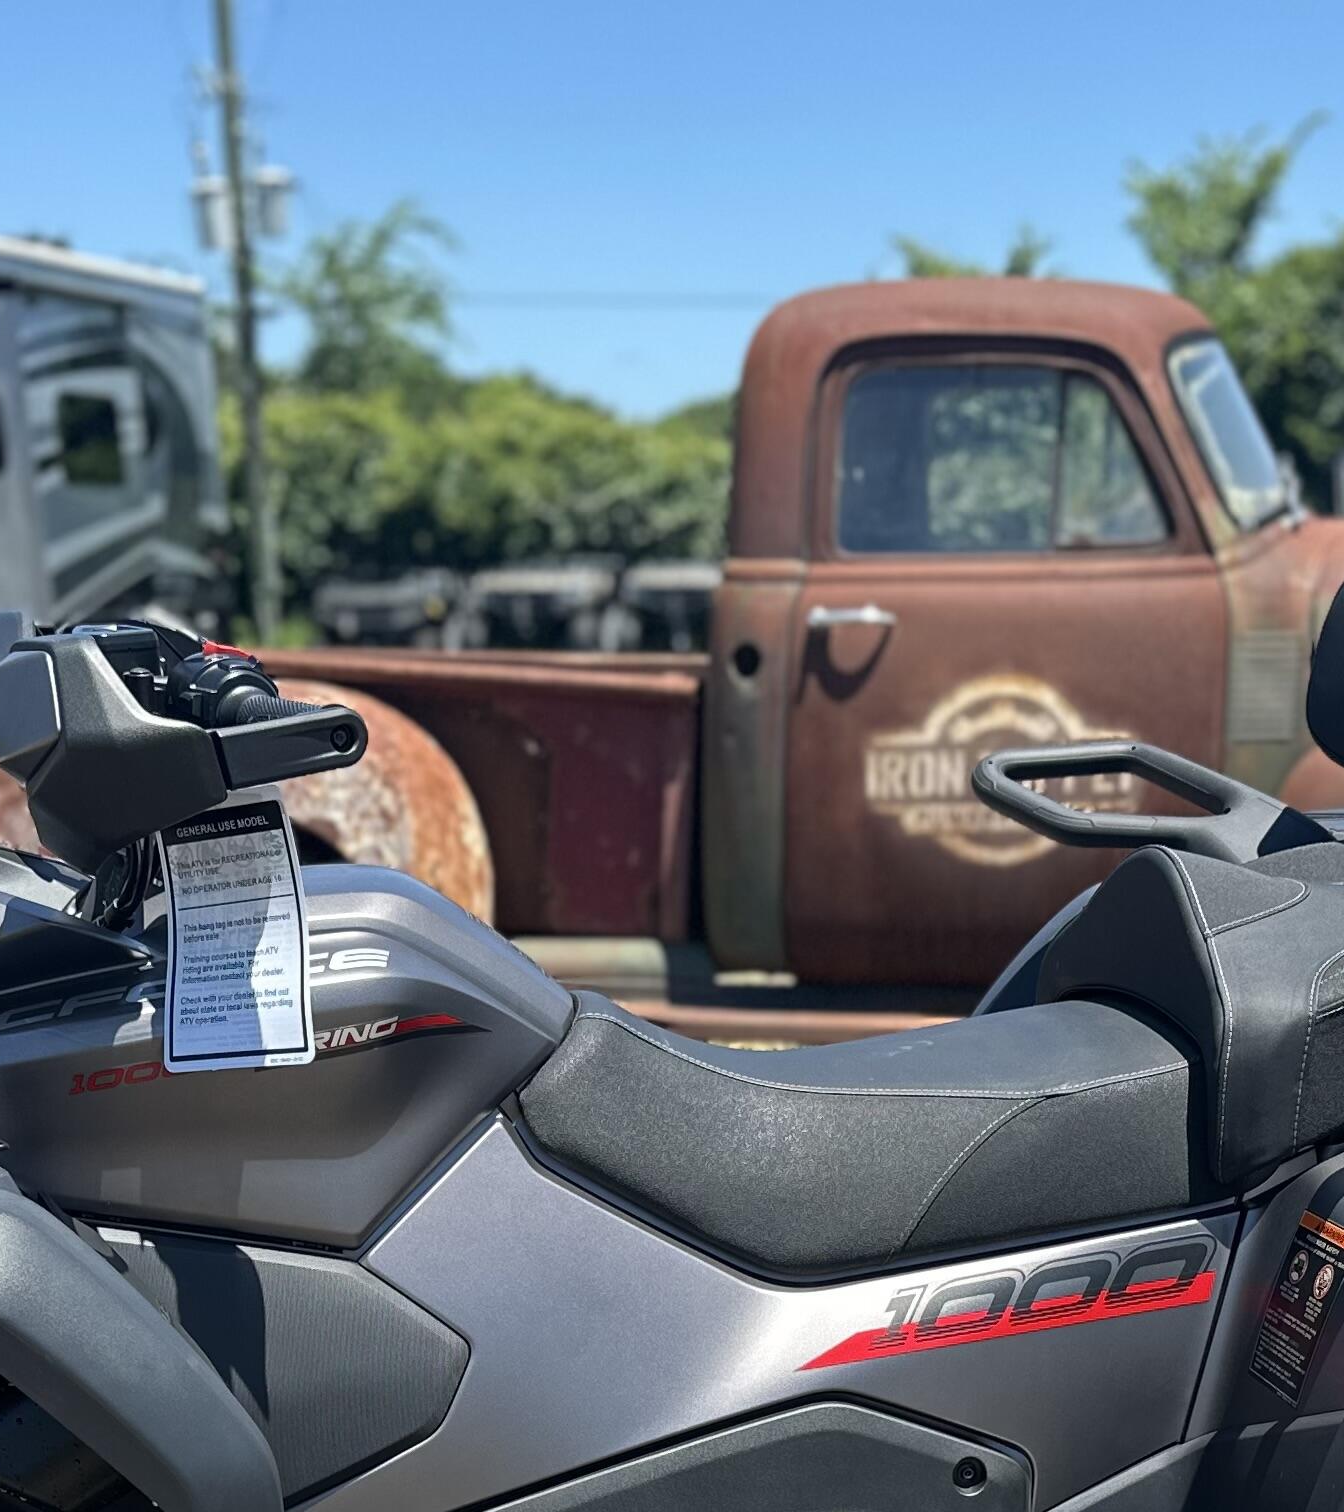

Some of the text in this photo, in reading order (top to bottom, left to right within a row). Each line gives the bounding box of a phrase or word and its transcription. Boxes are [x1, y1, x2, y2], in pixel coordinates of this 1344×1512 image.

[865, 749, 966, 798] IRON
[176, 815, 269, 838] GENERAL USE MODEL
[182, 886, 192, 895] NO
[193, 881, 232, 894] OPERATOR
[232, 879, 257, 890] UNDER
[184, 924, 197, 933] This
[216, 921, 225, 930] tag
[244, 917, 252, 926] to
[252, 915, 261, 924] be
[183, 954, 210, 964] Training
[211, 952, 237, 962] courses
[264, 946, 279, 956] ATV
[181, 996, 201, 1005] Check
[180, 1017, 194, 1026] ATV
[69, 1060, 173, 1096] 100
[868, 1236, 1214, 1352] 1000
